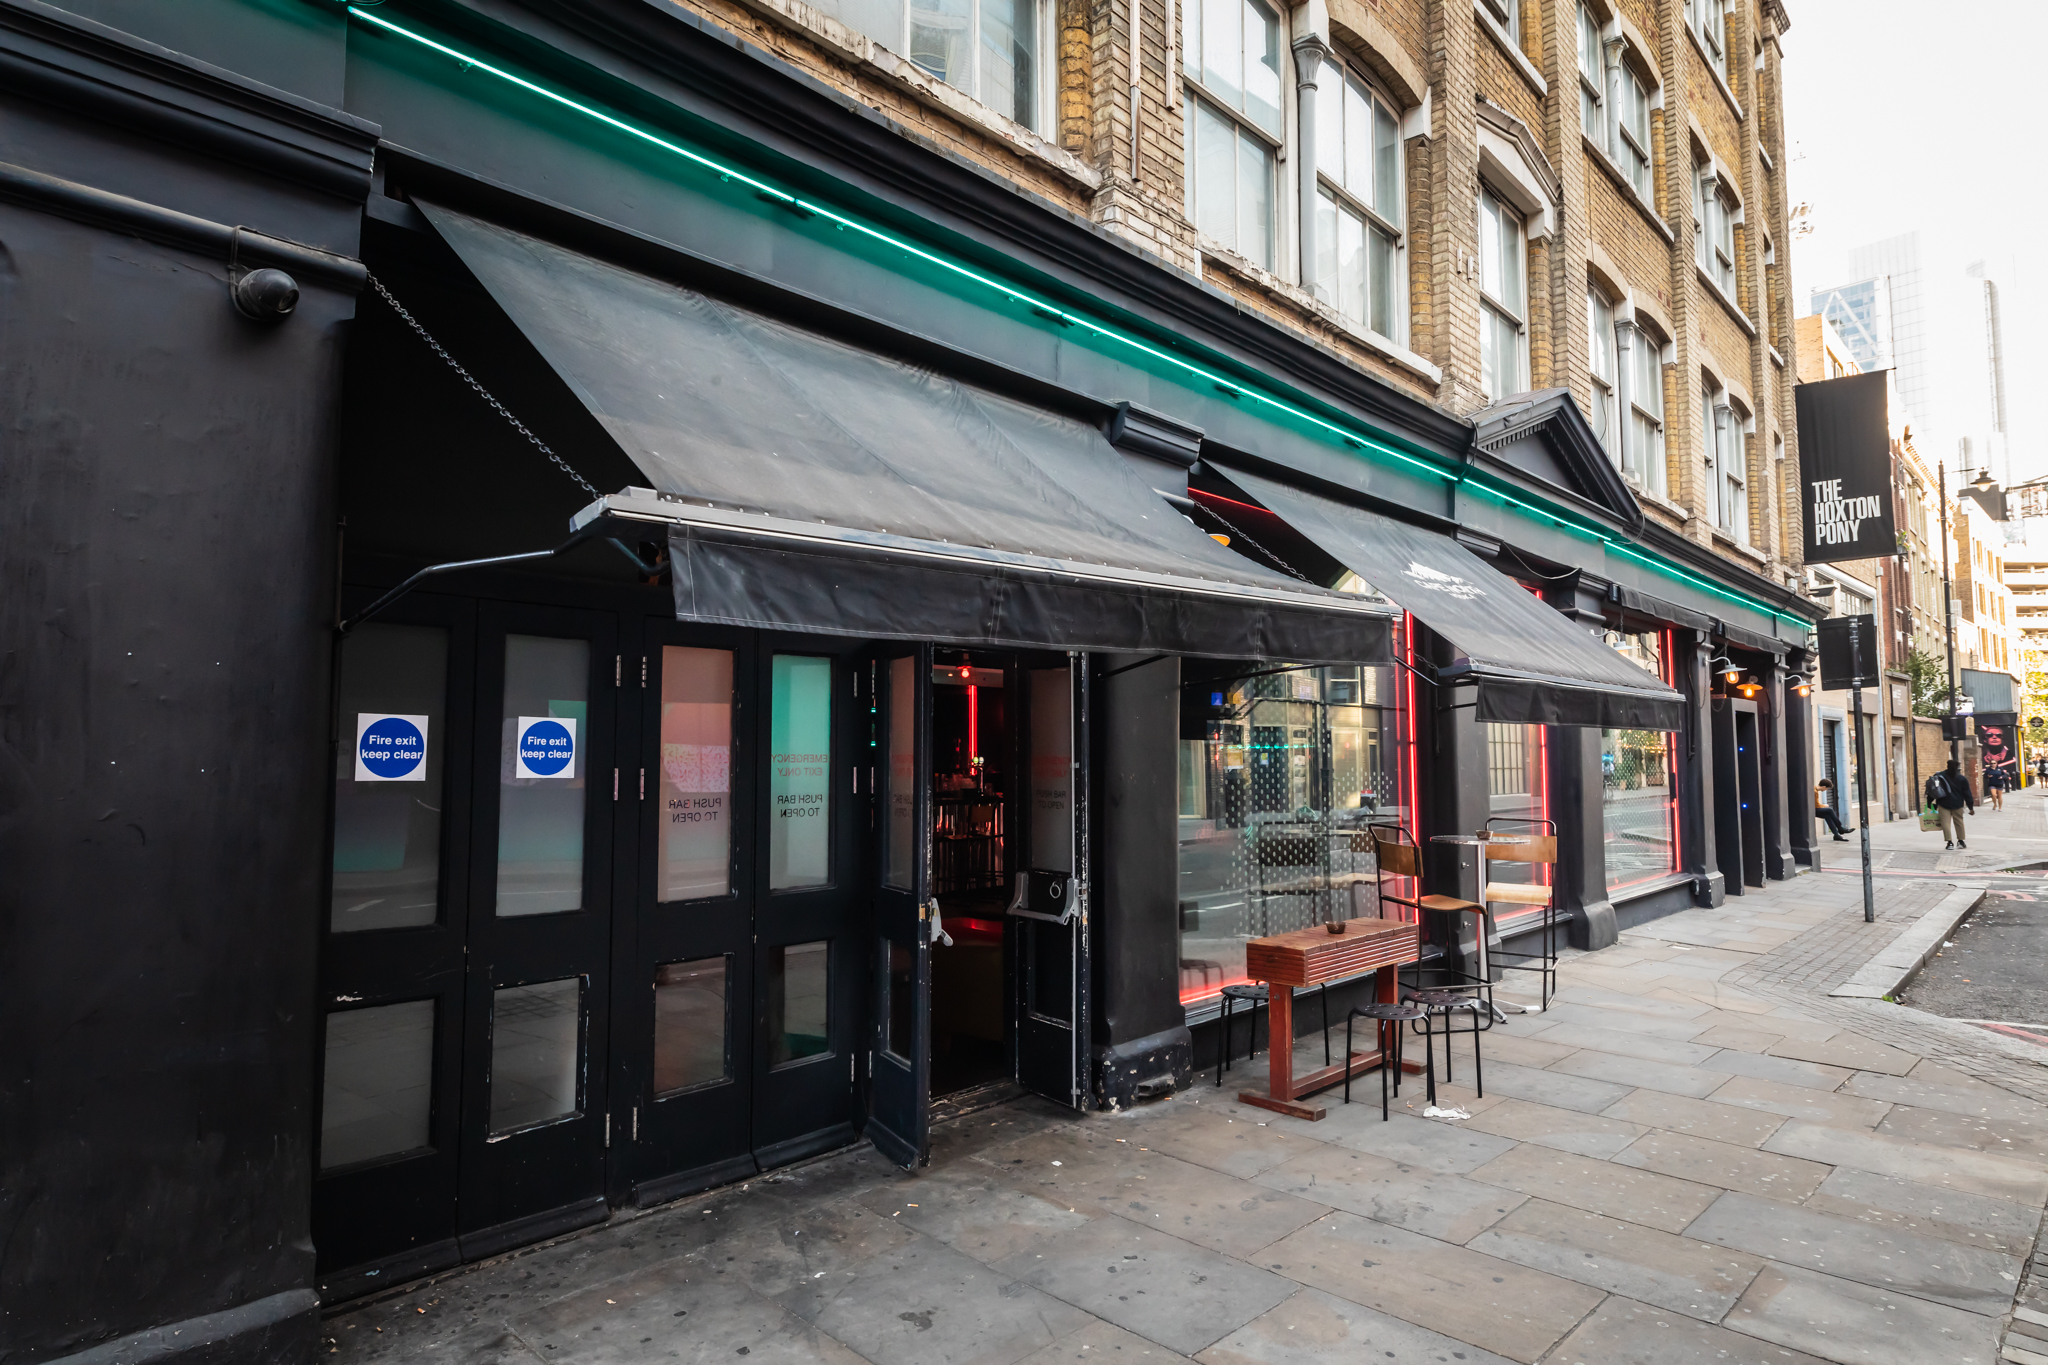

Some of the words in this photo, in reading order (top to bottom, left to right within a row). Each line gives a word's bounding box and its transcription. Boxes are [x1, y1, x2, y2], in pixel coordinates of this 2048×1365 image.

[1811, 478, 1843, 503] THE
[1814, 495, 1881, 525] HOXTON
[1815, 519, 1860, 546] PONY
[369, 735, 392, 745] Fire
[395, 736, 416, 746] exit
[527, 736, 547, 746] Fire
[549, 737, 567, 746] exit
[361, 749, 390, 761] keep
[393, 750, 422, 759] clear
[521, 749, 545, 760] keep
[547, 750, 571, 758] clear
[1053, 790, 1067, 798] BAR
[1047, 801, 1064, 809] OPEN
